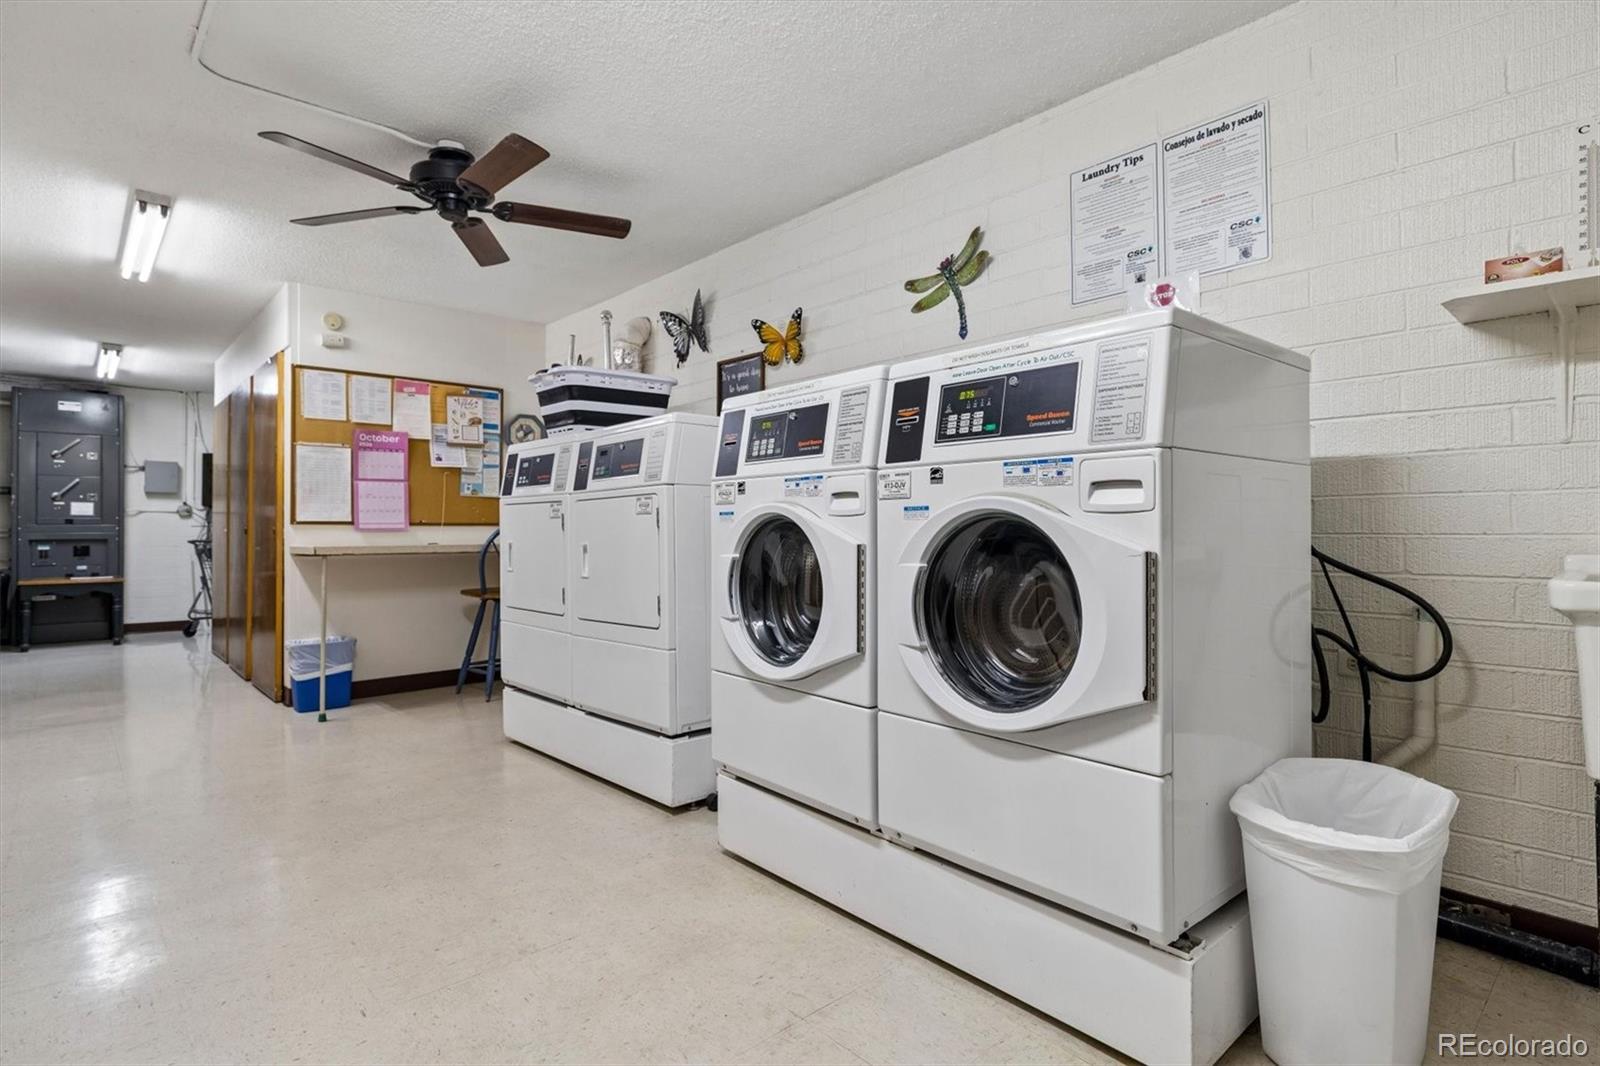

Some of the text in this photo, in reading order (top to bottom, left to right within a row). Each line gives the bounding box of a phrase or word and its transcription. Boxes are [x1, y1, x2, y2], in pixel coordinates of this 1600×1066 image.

[1164, 110, 1263, 152] Consejos de lavado y secado
[1578, 124, 1591, 135] C
[1081, 153, 1145, 182] Laundry Tips
[1230, 218, 1253, 230] CSC
[1127, 247, 1147, 259] CSC
[1026, 412, 1047, 421] Speed
[359, 433, 400, 443] October
